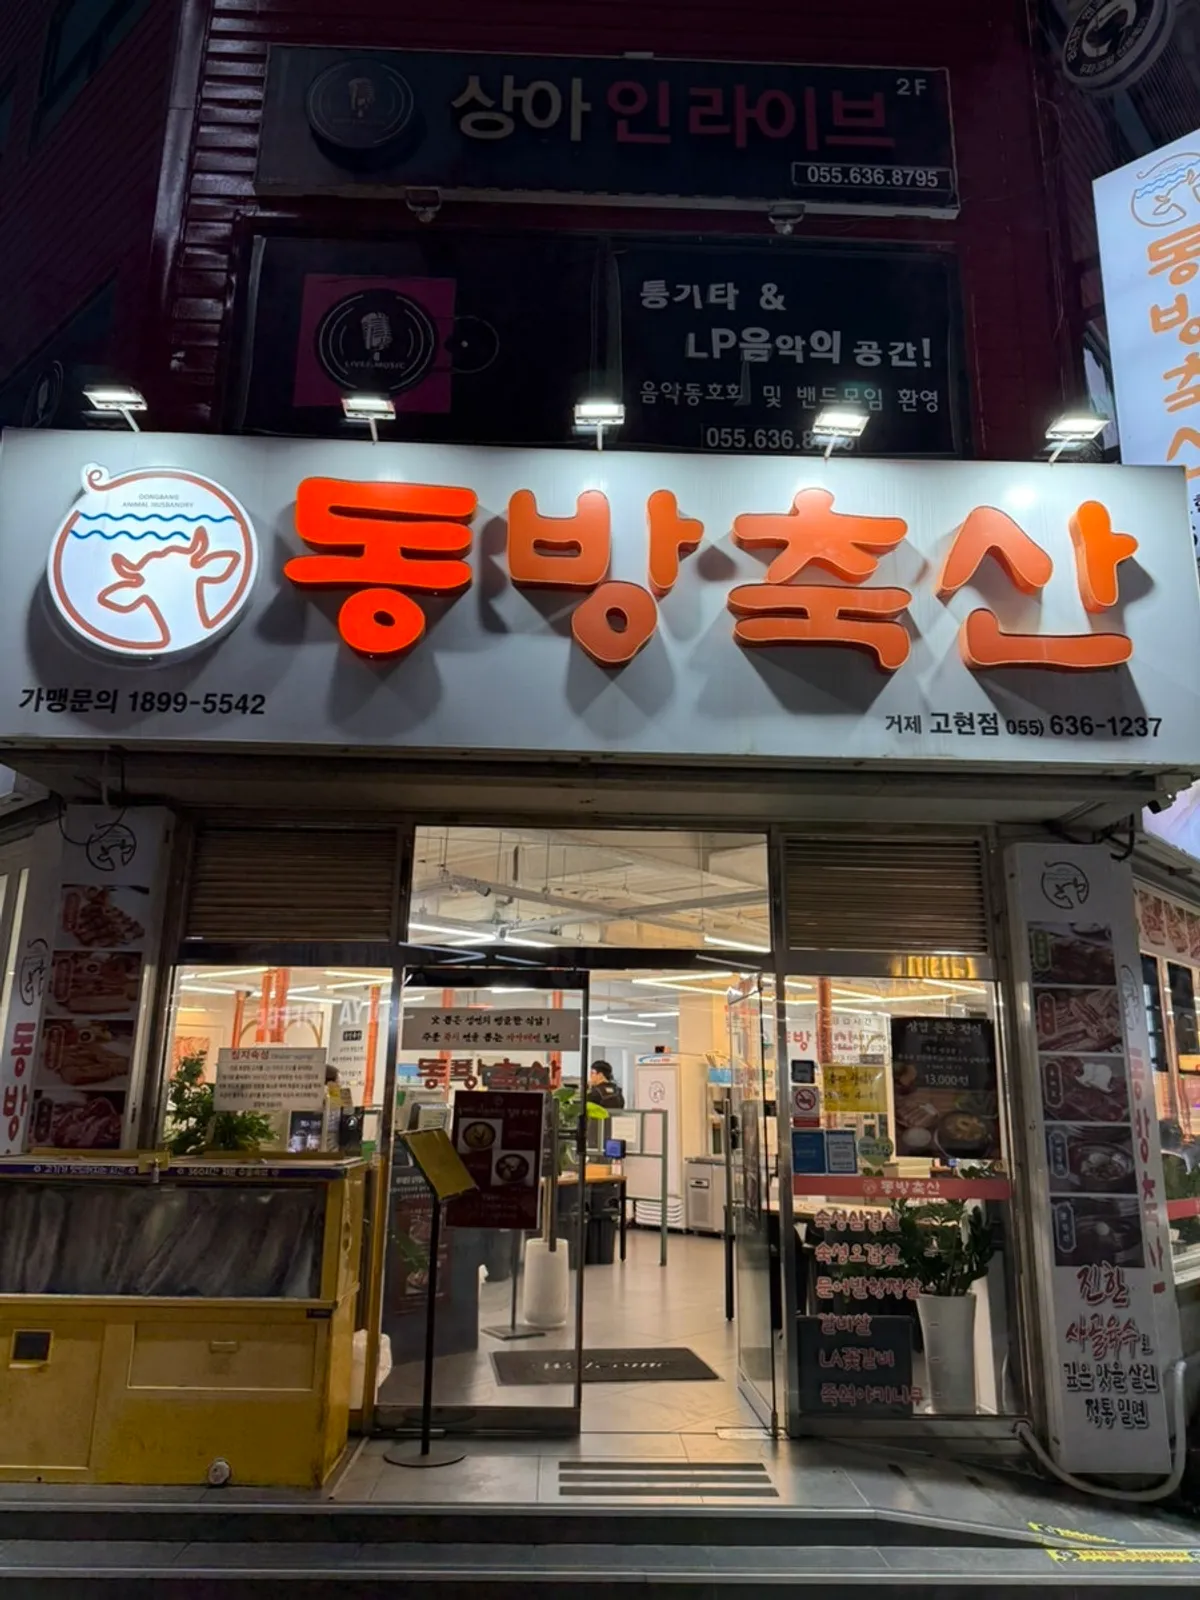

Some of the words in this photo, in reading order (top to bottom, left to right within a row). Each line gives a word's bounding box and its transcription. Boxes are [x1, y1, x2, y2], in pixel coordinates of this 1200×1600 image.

[895, 77, 928, 97] 2F
[805, 164, 939, 189] 055.636.8795
[640, 279, 739, 311] 통기타
[759, 282, 787, 312] &
[853, 336, 933, 368] 공간!
[640, 380, 746, 408] 음악동호회
[762, 385, 782, 409] 및
[797, 385, 884, 412] 밴드모임
[898, 388, 939, 414] 환영
[284, 476, 1139, 672] 동방축산
[19, 687, 119, 714] 가맹문의
[128, 691, 267, 715] 1899-5542
[885, 714, 922, 735] 거제
[929, 711, 1000, 737] 고현점
[1006, 718, 1045, 738] 055)
[1050, 714, 1163, 738] 636-1237
[880, 1180, 941, 1196] 동방축산
[814, 1208, 900, 1232] 숙성삼겹살
[814, 1243, 902, 1265] 숙성오겹살
[1076, 1261, 1129, 1308] 진한
[1063, 1361, 1095, 1391] 깊은
[1096, 1361, 1127, 1392] 맛을
[1128, 1363, 1160, 1394] 살린
